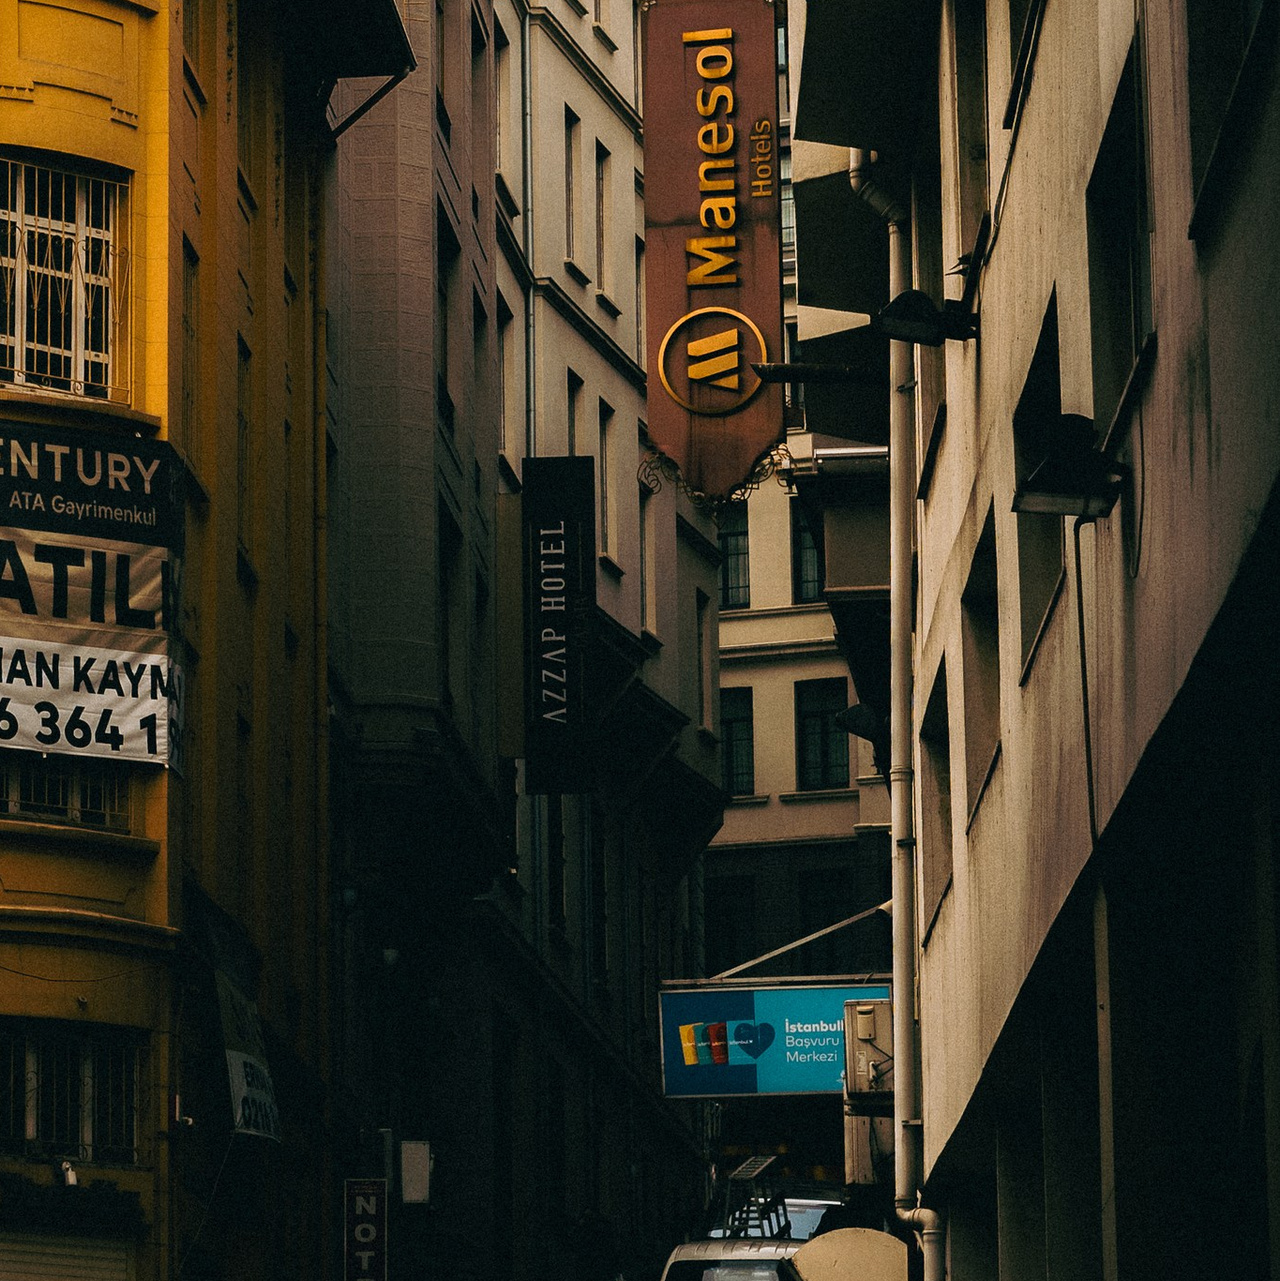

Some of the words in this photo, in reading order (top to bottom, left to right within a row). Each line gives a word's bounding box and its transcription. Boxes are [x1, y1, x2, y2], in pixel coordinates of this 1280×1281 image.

[682, 27, 740, 288] Manesol
[751, 119, 773, 199] Hotels
[9, 490, 46, 513] ATA
[51, 494, 157, 527] Gayrimenkul
[540, 520, 566, 613] HOTEL
[35, 701, 124, 752] 364
[785, 1035, 840, 1049] Başvuru
[786, 1050, 838, 1063] Merkezi
